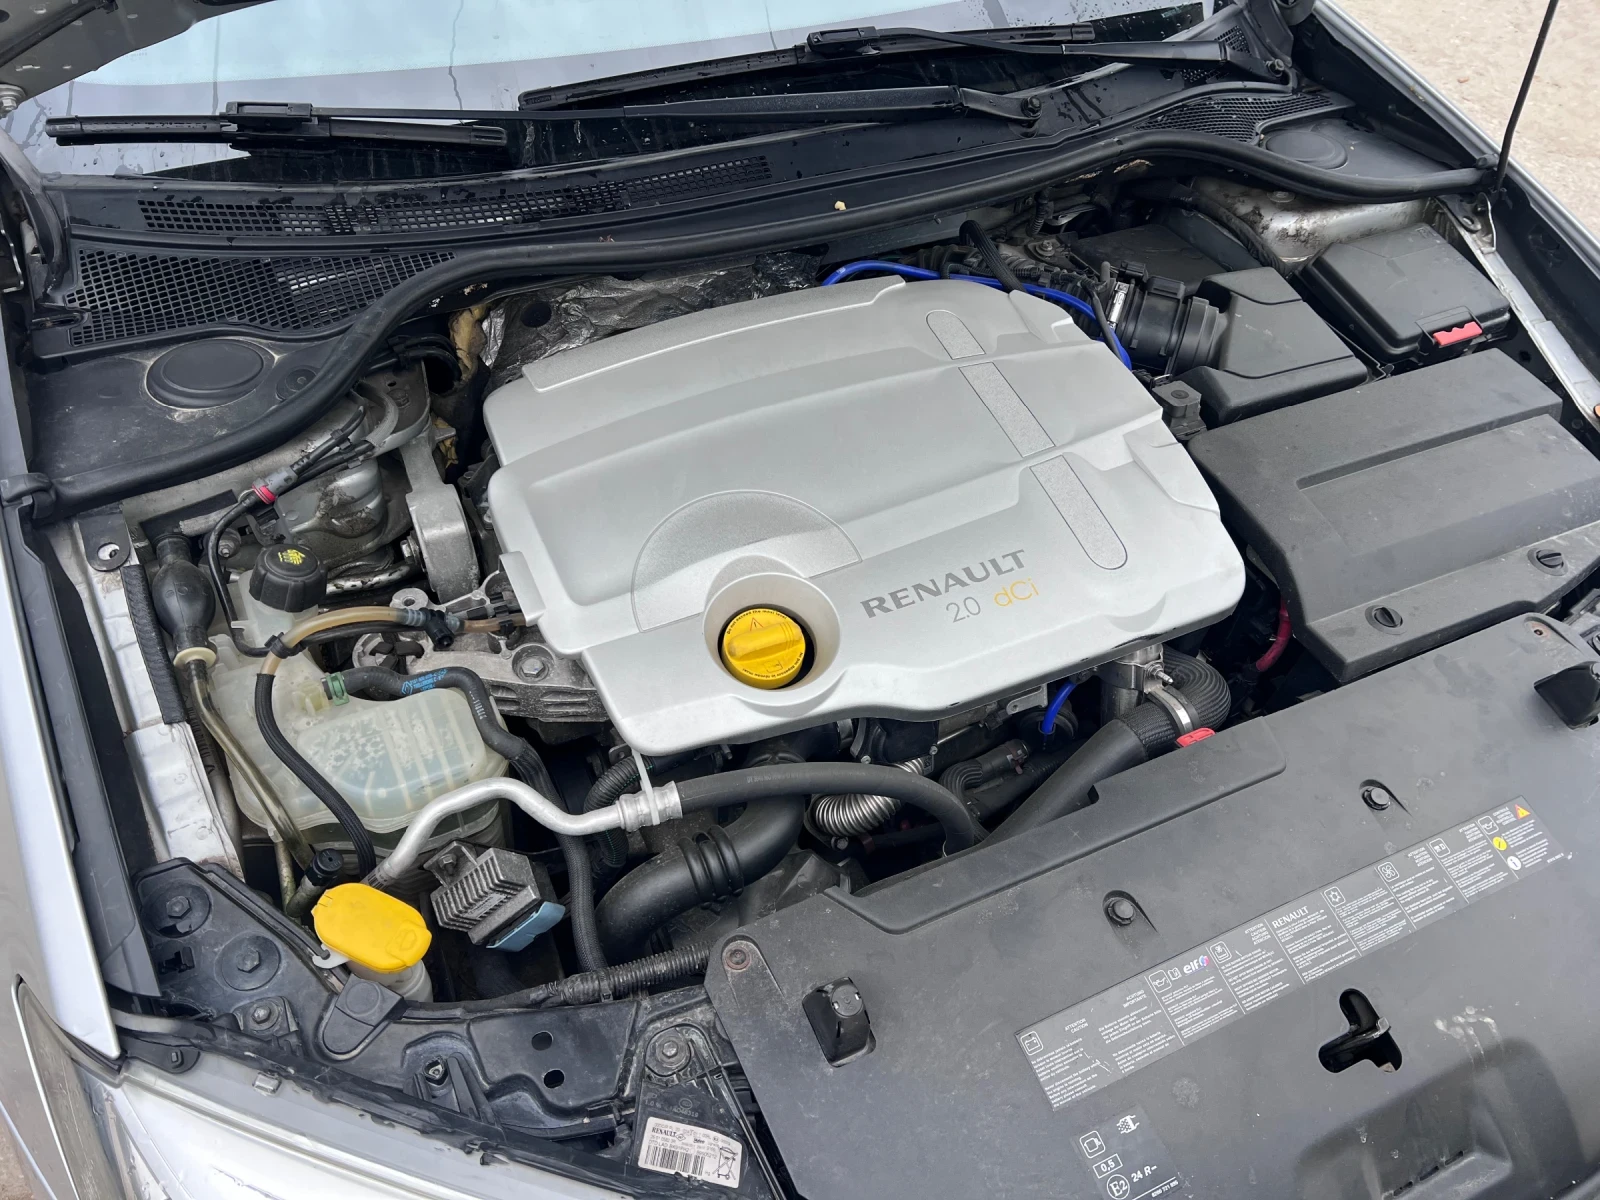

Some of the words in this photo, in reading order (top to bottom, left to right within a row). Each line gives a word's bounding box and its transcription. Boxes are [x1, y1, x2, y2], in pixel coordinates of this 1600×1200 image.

[860, 549, 1025, 618] RENAULT
[945, 596, 981, 623] 2.0
[993, 577, 1039, 607] dCi
[1271, 905, 1309, 929] RENAULT
[1183, 957, 1202, 975] elf
[651, 1126, 677, 1137] RENAULT
[1100, 1159, 1115, 1172] 0,5
[1109, 1180, 1128, 1197] E2
[1131, 1170, 1143, 1183] 24
